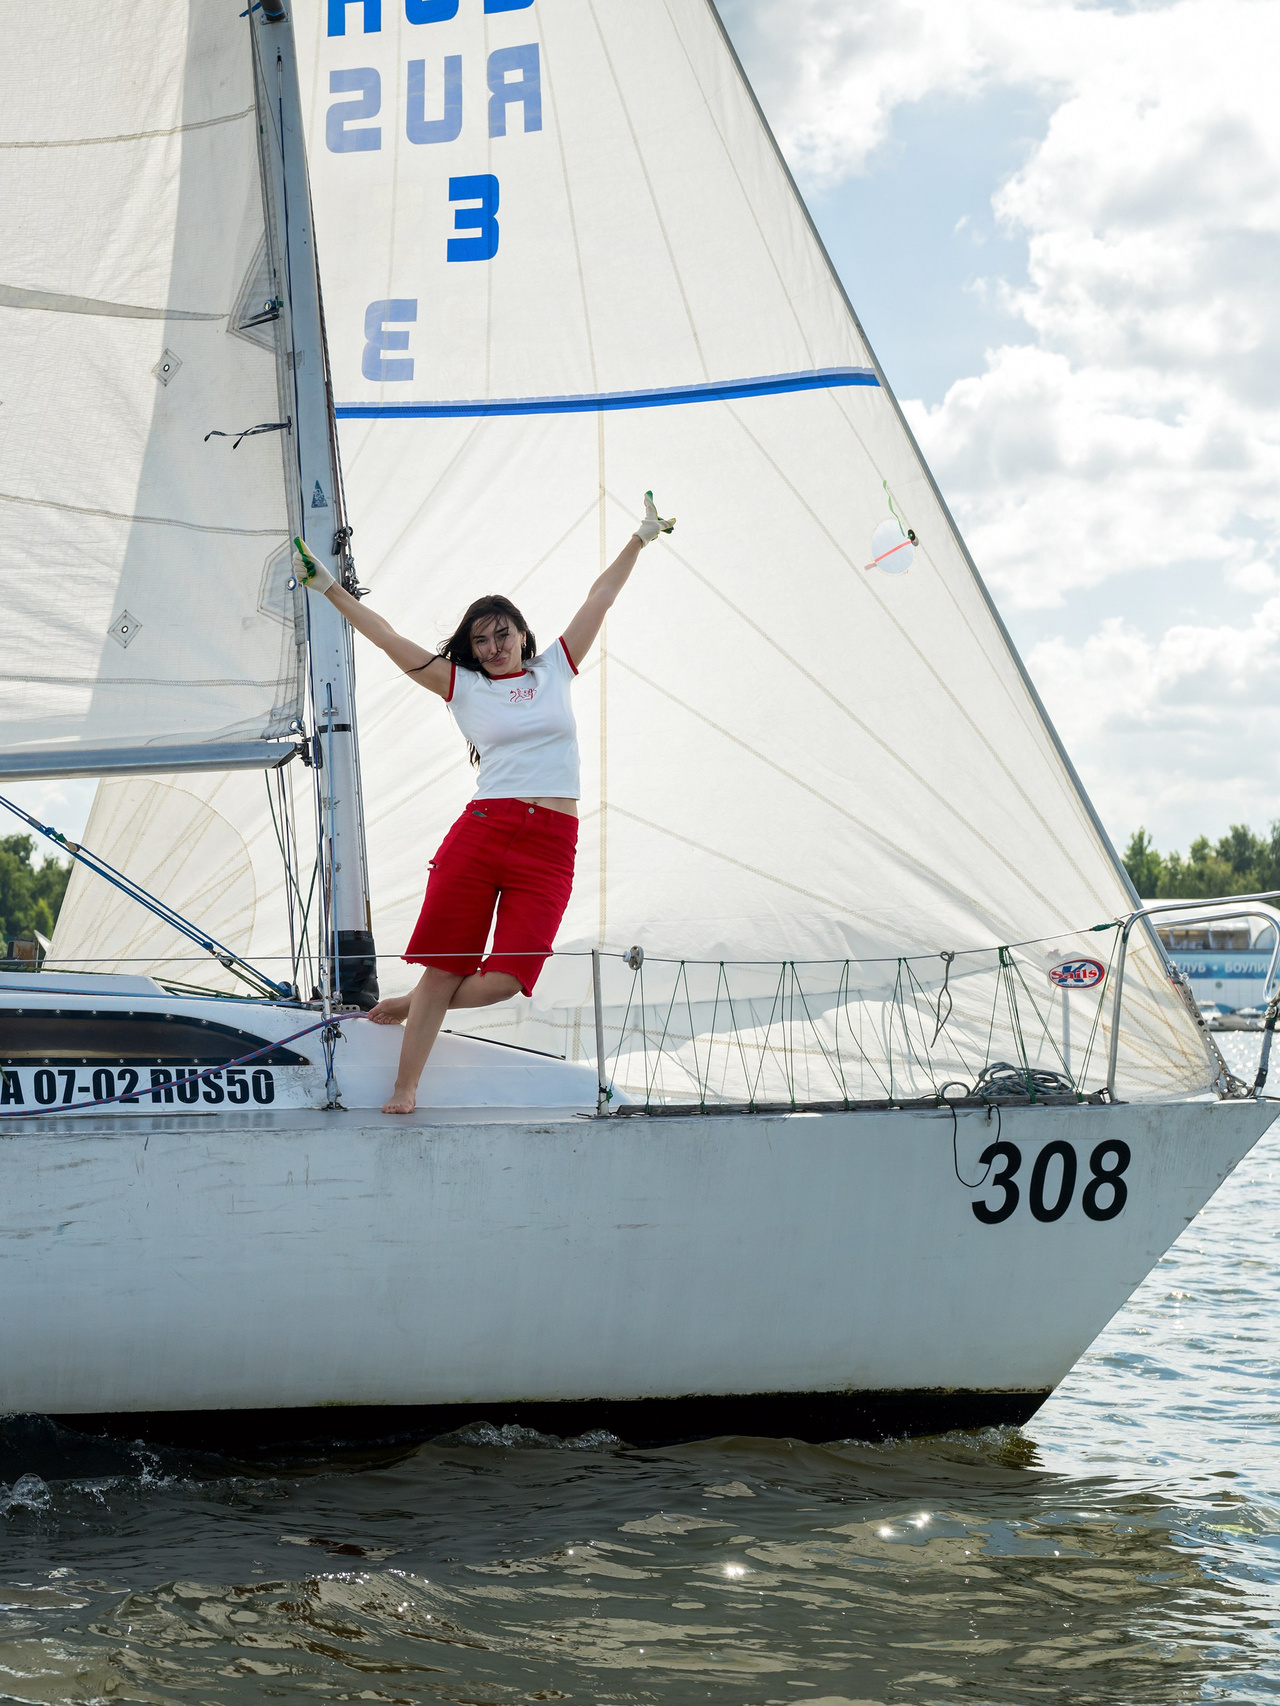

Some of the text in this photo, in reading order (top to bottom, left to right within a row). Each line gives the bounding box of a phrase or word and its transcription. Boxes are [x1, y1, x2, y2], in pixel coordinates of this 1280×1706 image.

[447, 174, 500, 262] 3
[1051, 969, 1097, 980] Sails
[33, 1069, 140, 1105] 07-02
[151, 1068, 275, 1105] RUS50
[972, 1139, 1131, 1224] 308
